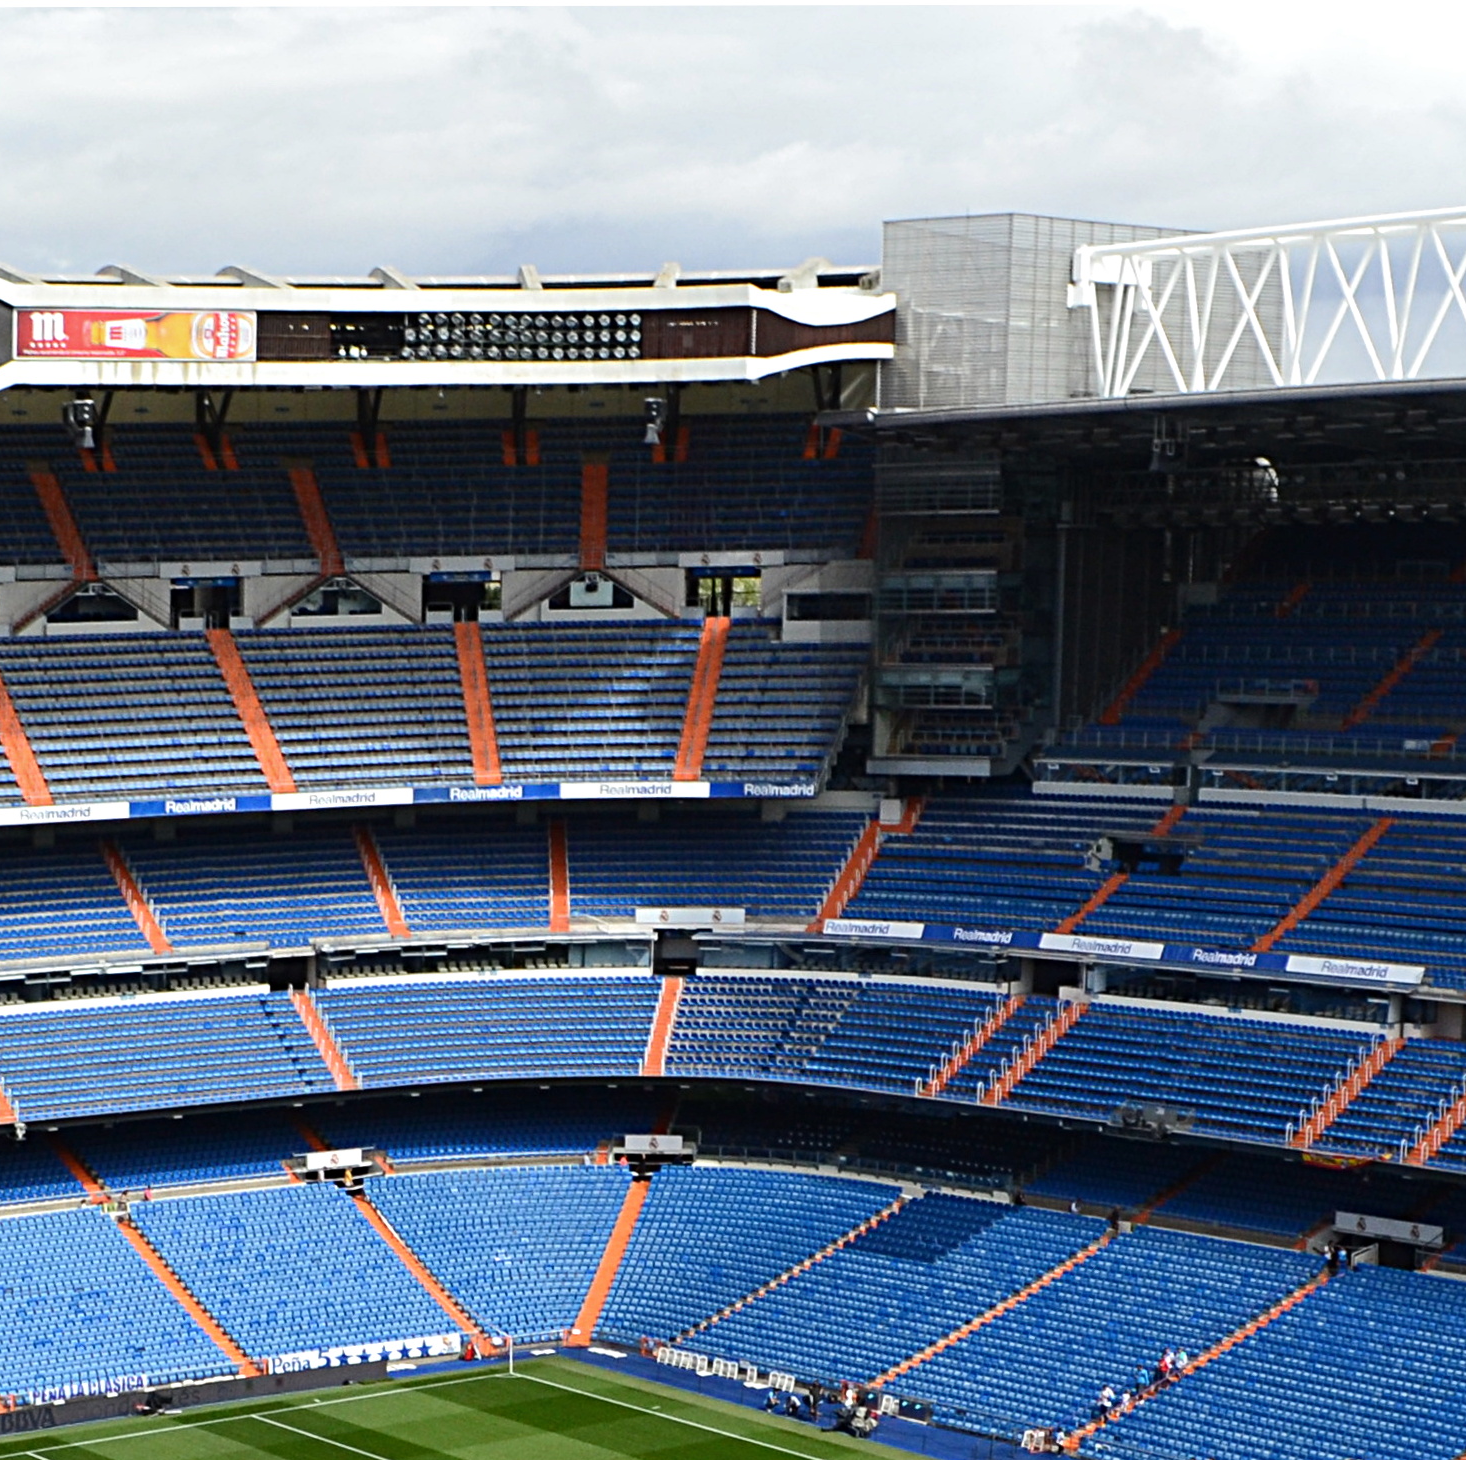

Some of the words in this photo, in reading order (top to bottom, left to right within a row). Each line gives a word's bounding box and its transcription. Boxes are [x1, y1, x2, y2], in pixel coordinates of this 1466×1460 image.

[450, 786, 522, 801] Realmadrid
[599, 782, 672, 796] Realmadrid
[744, 782, 814, 797] Realmadrid
[165, 797, 235, 814] Realmadrid
[309, 791, 375, 806] Realmadrid
[20, 806, 91, 821] Realmadrid
[824, 920, 890, 936] Realmadrid
[953, 928, 1012, 944] Realmadrid
[1071, 937, 1132, 955] Realmadrid
[1192, 949, 1256, 966] Realmadrid
[1321, 960, 1388, 979] Realmadrid
[1, 1407, 56, 1432] BBVA
